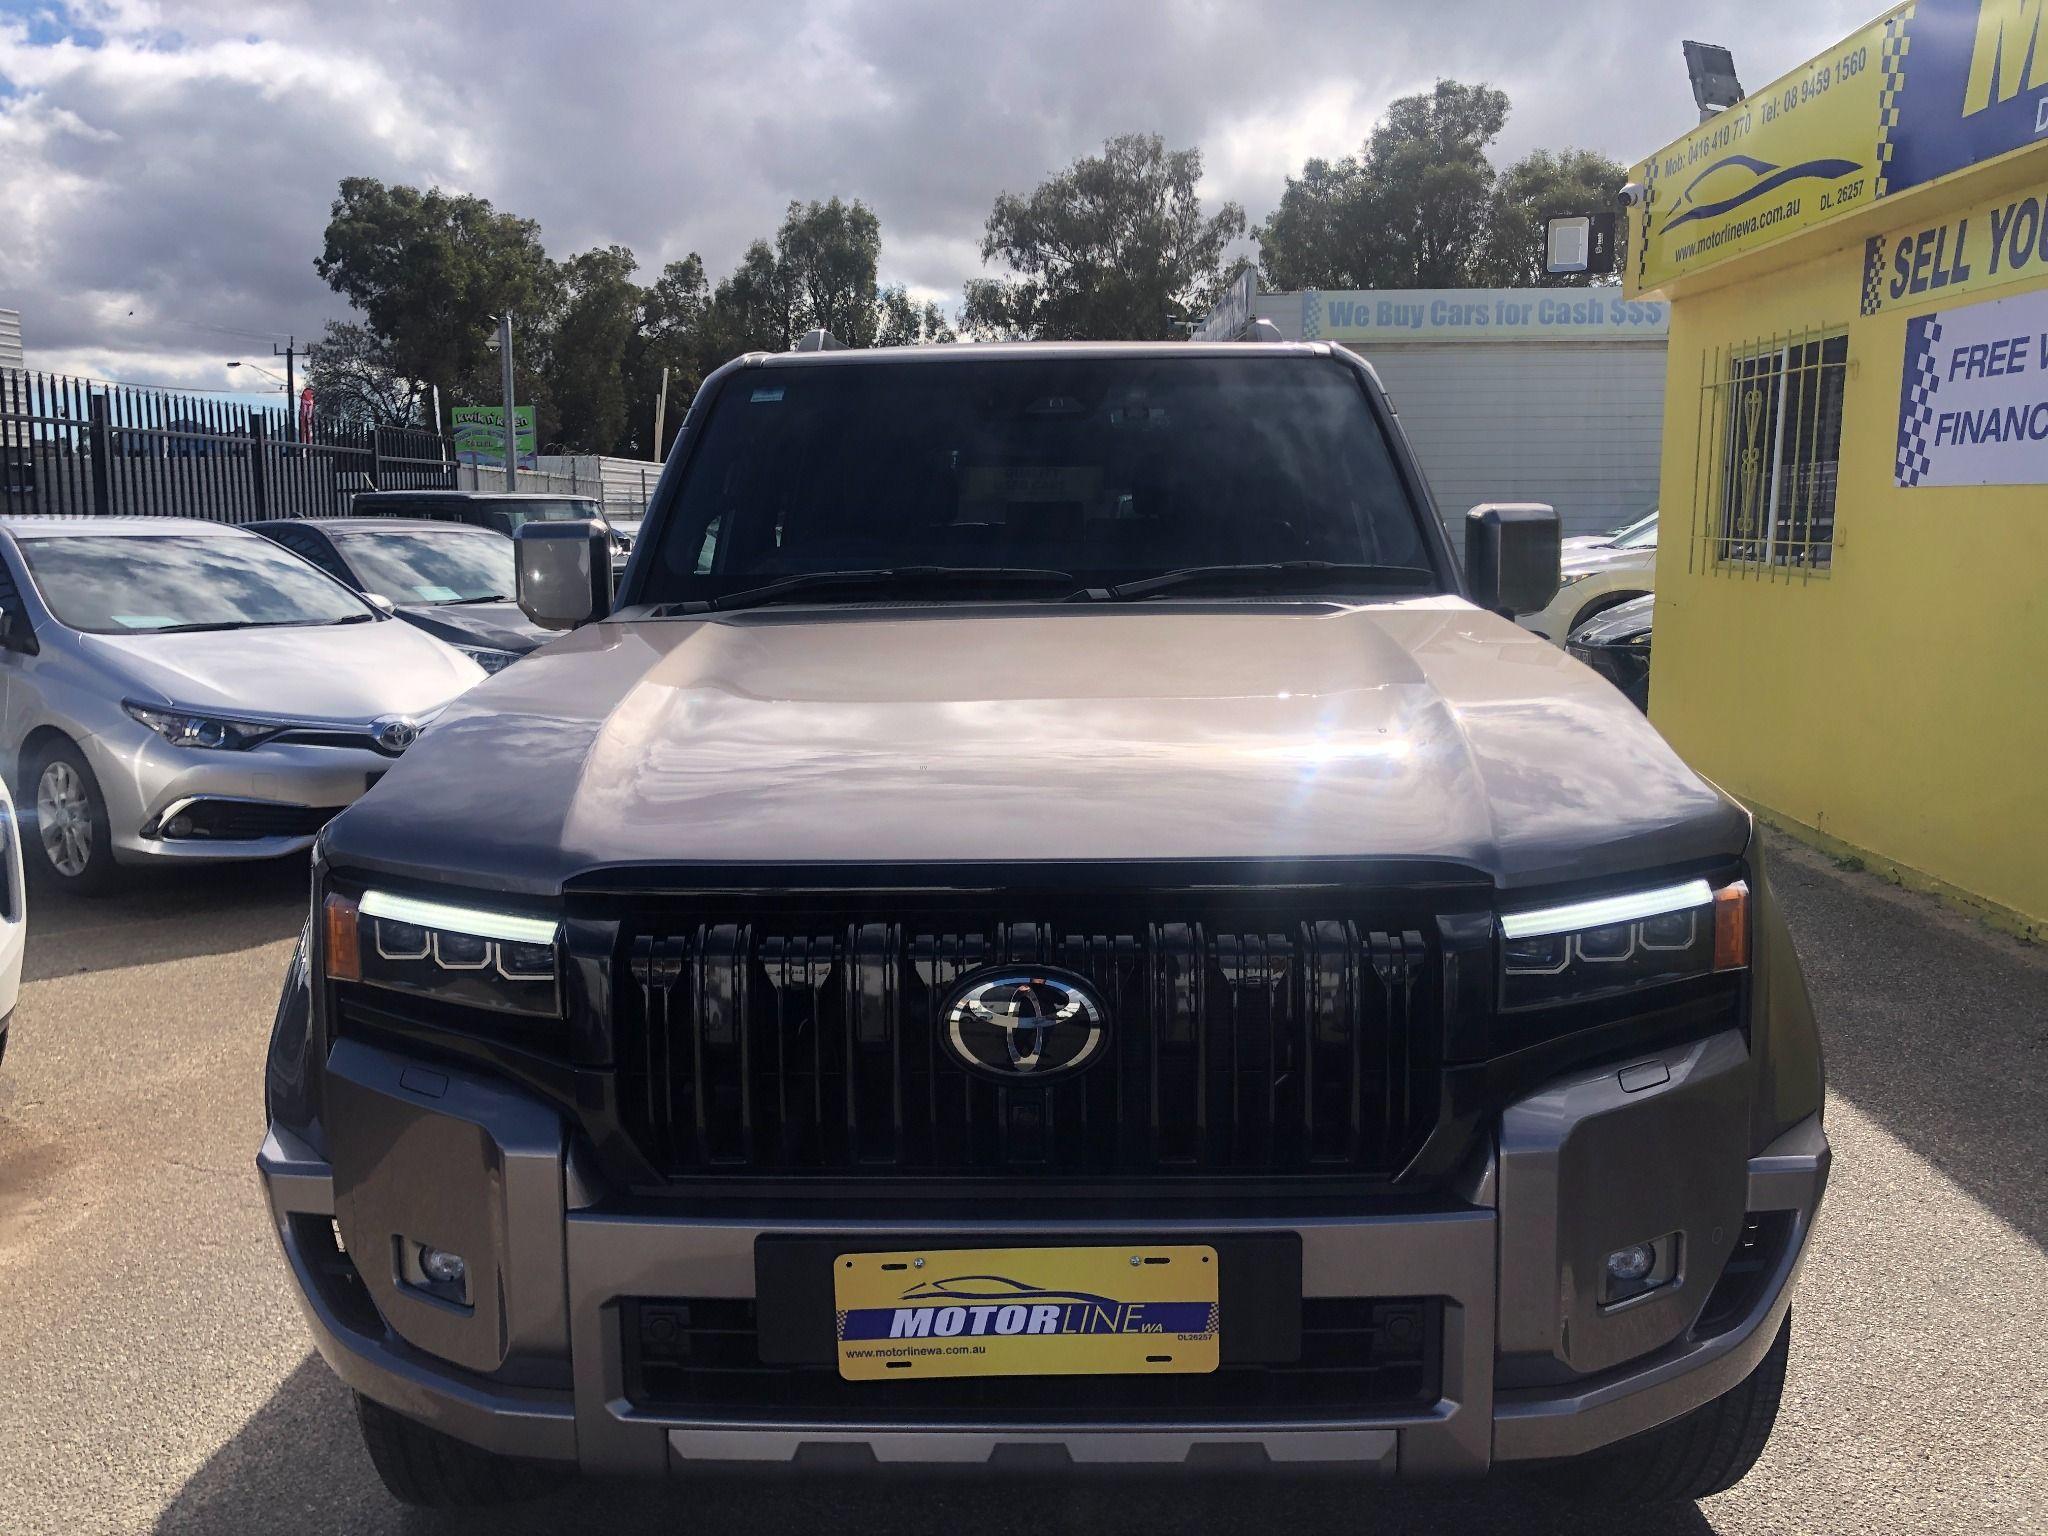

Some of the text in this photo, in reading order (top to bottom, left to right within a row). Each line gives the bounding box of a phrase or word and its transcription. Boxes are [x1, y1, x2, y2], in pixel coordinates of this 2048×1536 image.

[1664, 47, 1867, 179] Mob: 0416 410 770 Tel: 08 9459 1560
[1820, 180, 1865, 211] DL. 26257
[1675, 199, 1801, 262] www.motorlinewa.com.au
[1890, 218, 1971, 299] SELL
[1328, 297, 1662, 329] We Buy Cars for Cash $$$
[1948, 335, 2031, 382] FREE
[1935, 402, 2048, 446] FINANC
[846, 1345, 986, 1359] www.motorlinewa.com.au
